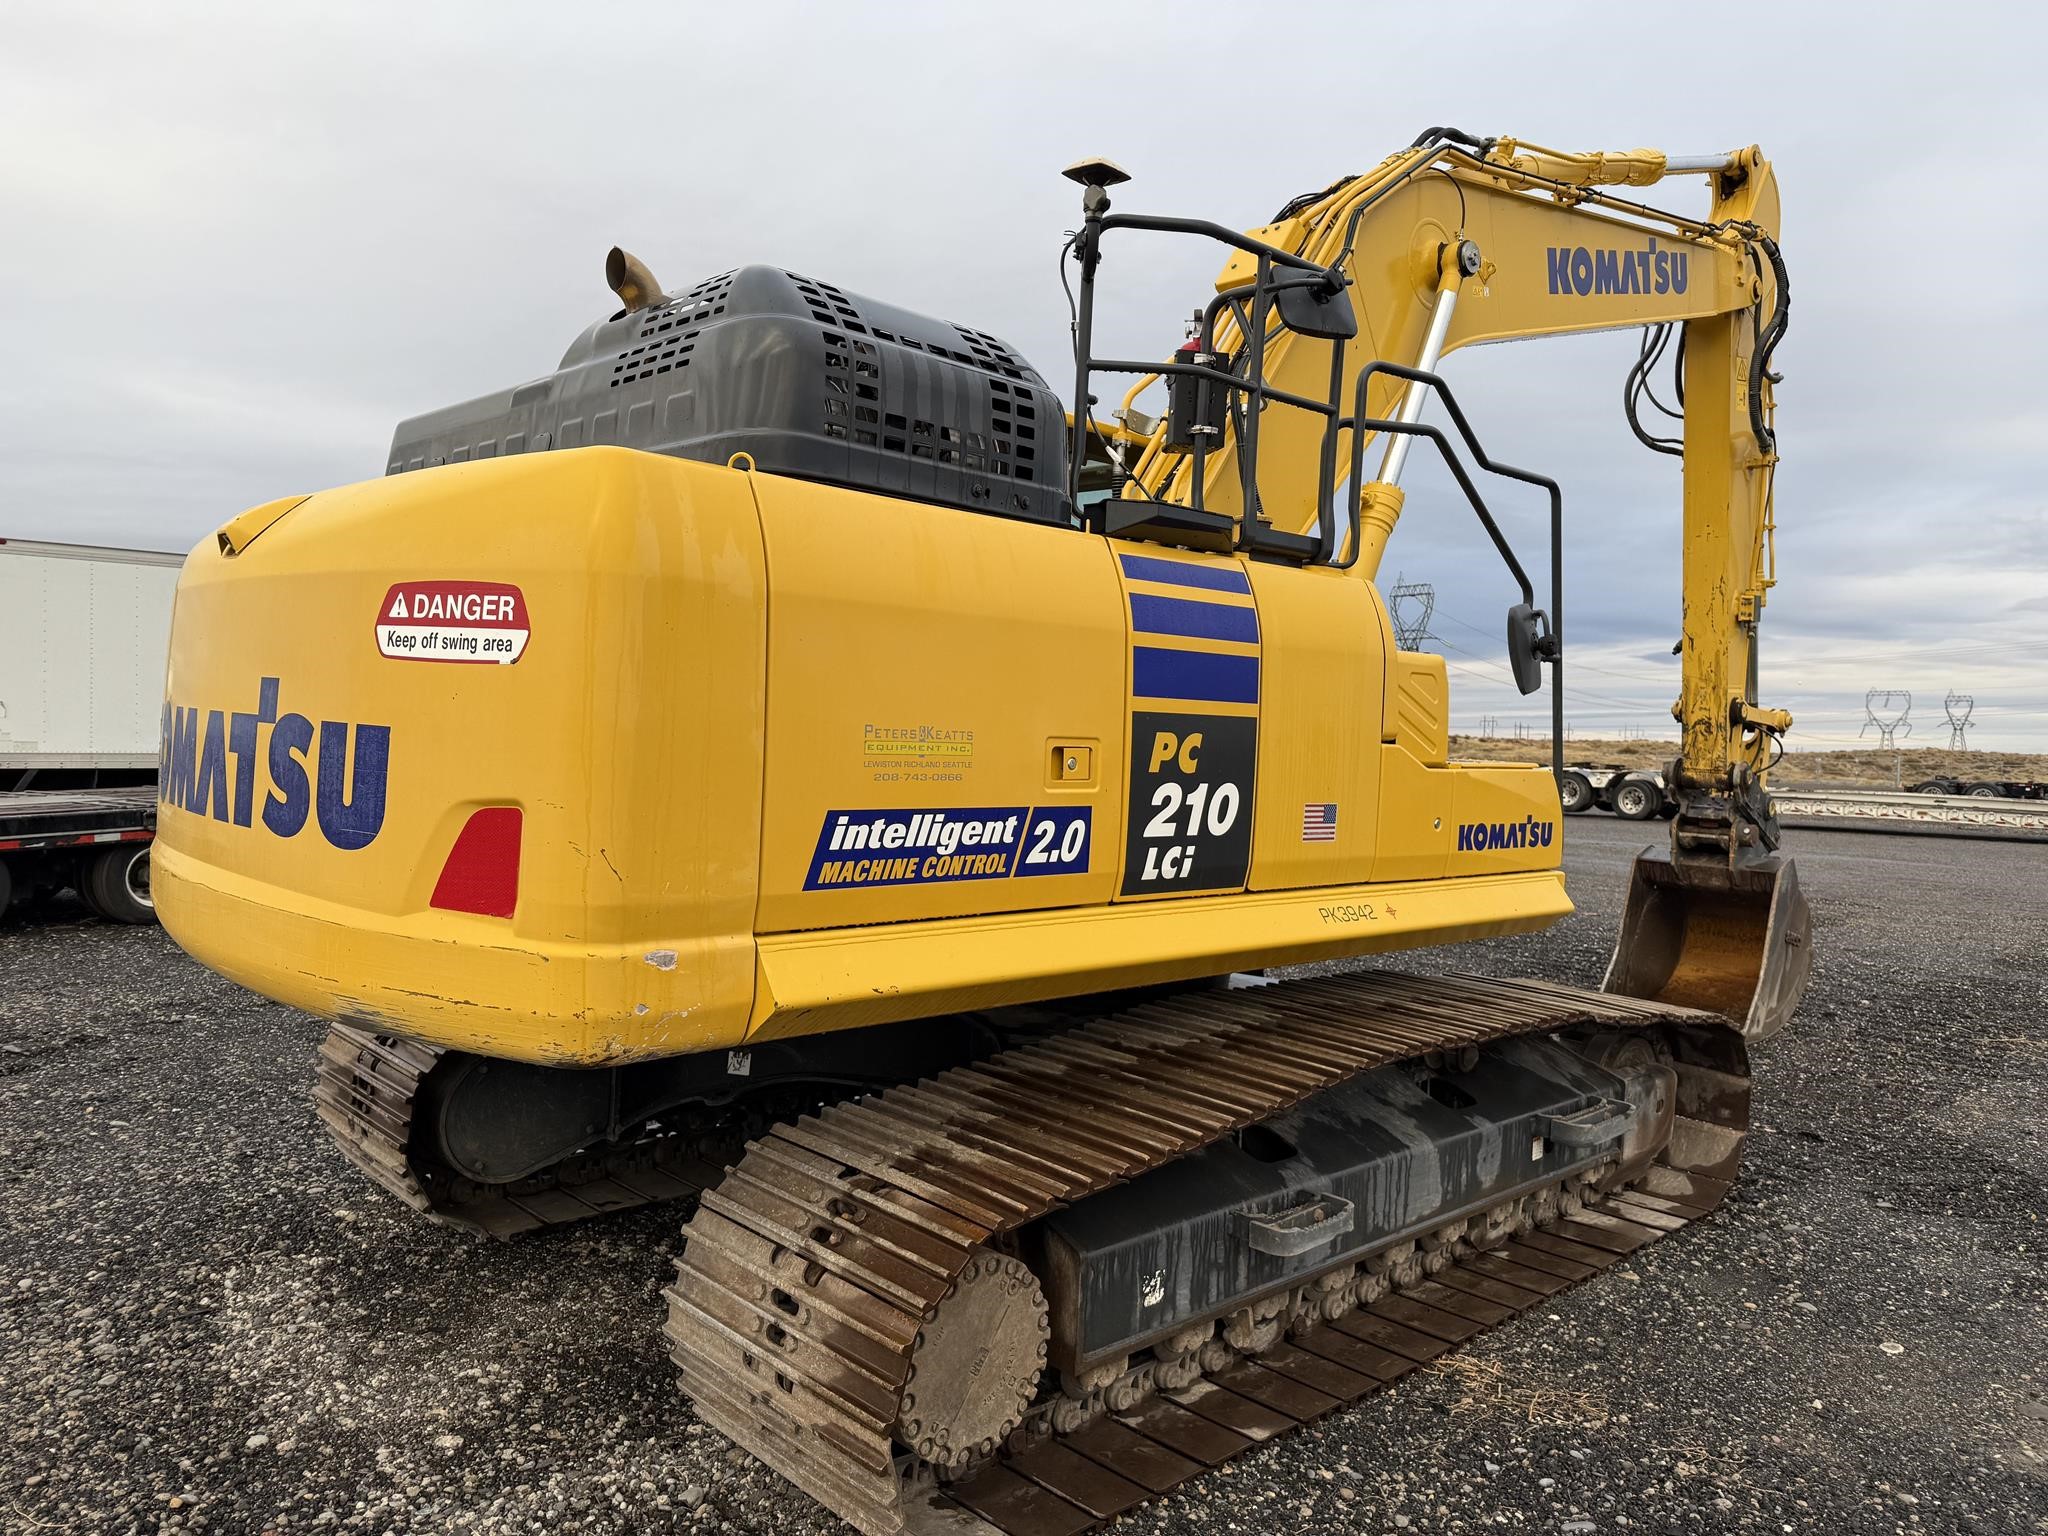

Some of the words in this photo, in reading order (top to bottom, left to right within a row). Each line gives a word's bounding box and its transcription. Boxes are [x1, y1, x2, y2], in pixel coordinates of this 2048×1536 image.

[1547, 237, 1688, 297] KOMATSU
[413, 593, 515, 621] DANGER
[387, 630, 417, 651] Keep
[421, 632, 439, 649] off
[441, 633, 477, 654] swing
[483, 636, 513, 652] area
[160, 677, 391, 850] OMATSU
[864, 761, 902, 769] LEWISTON
[904, 761, 941, 769] RICHLAND
[943, 761, 973, 769] SEATTLE
[867, 744, 942, 753] EQUIPMENT
[946, 745, 971, 753] INC.
[1148, 732, 1203, 774] PC
[873, 773, 963, 781] 208-743-0866
[1143, 782, 1240, 838] 210
[828, 813, 1018, 855] intelligent
[1025, 819, 1086, 863] 2.0
[1457, 814, 1554, 852] KOMATSU
[817, 857, 919, 884] MACHINE
[921, 853, 1007, 877] CONTROL
[1141, 845, 1196, 881] LCi
[1318, 904, 1378, 925] PK3942
